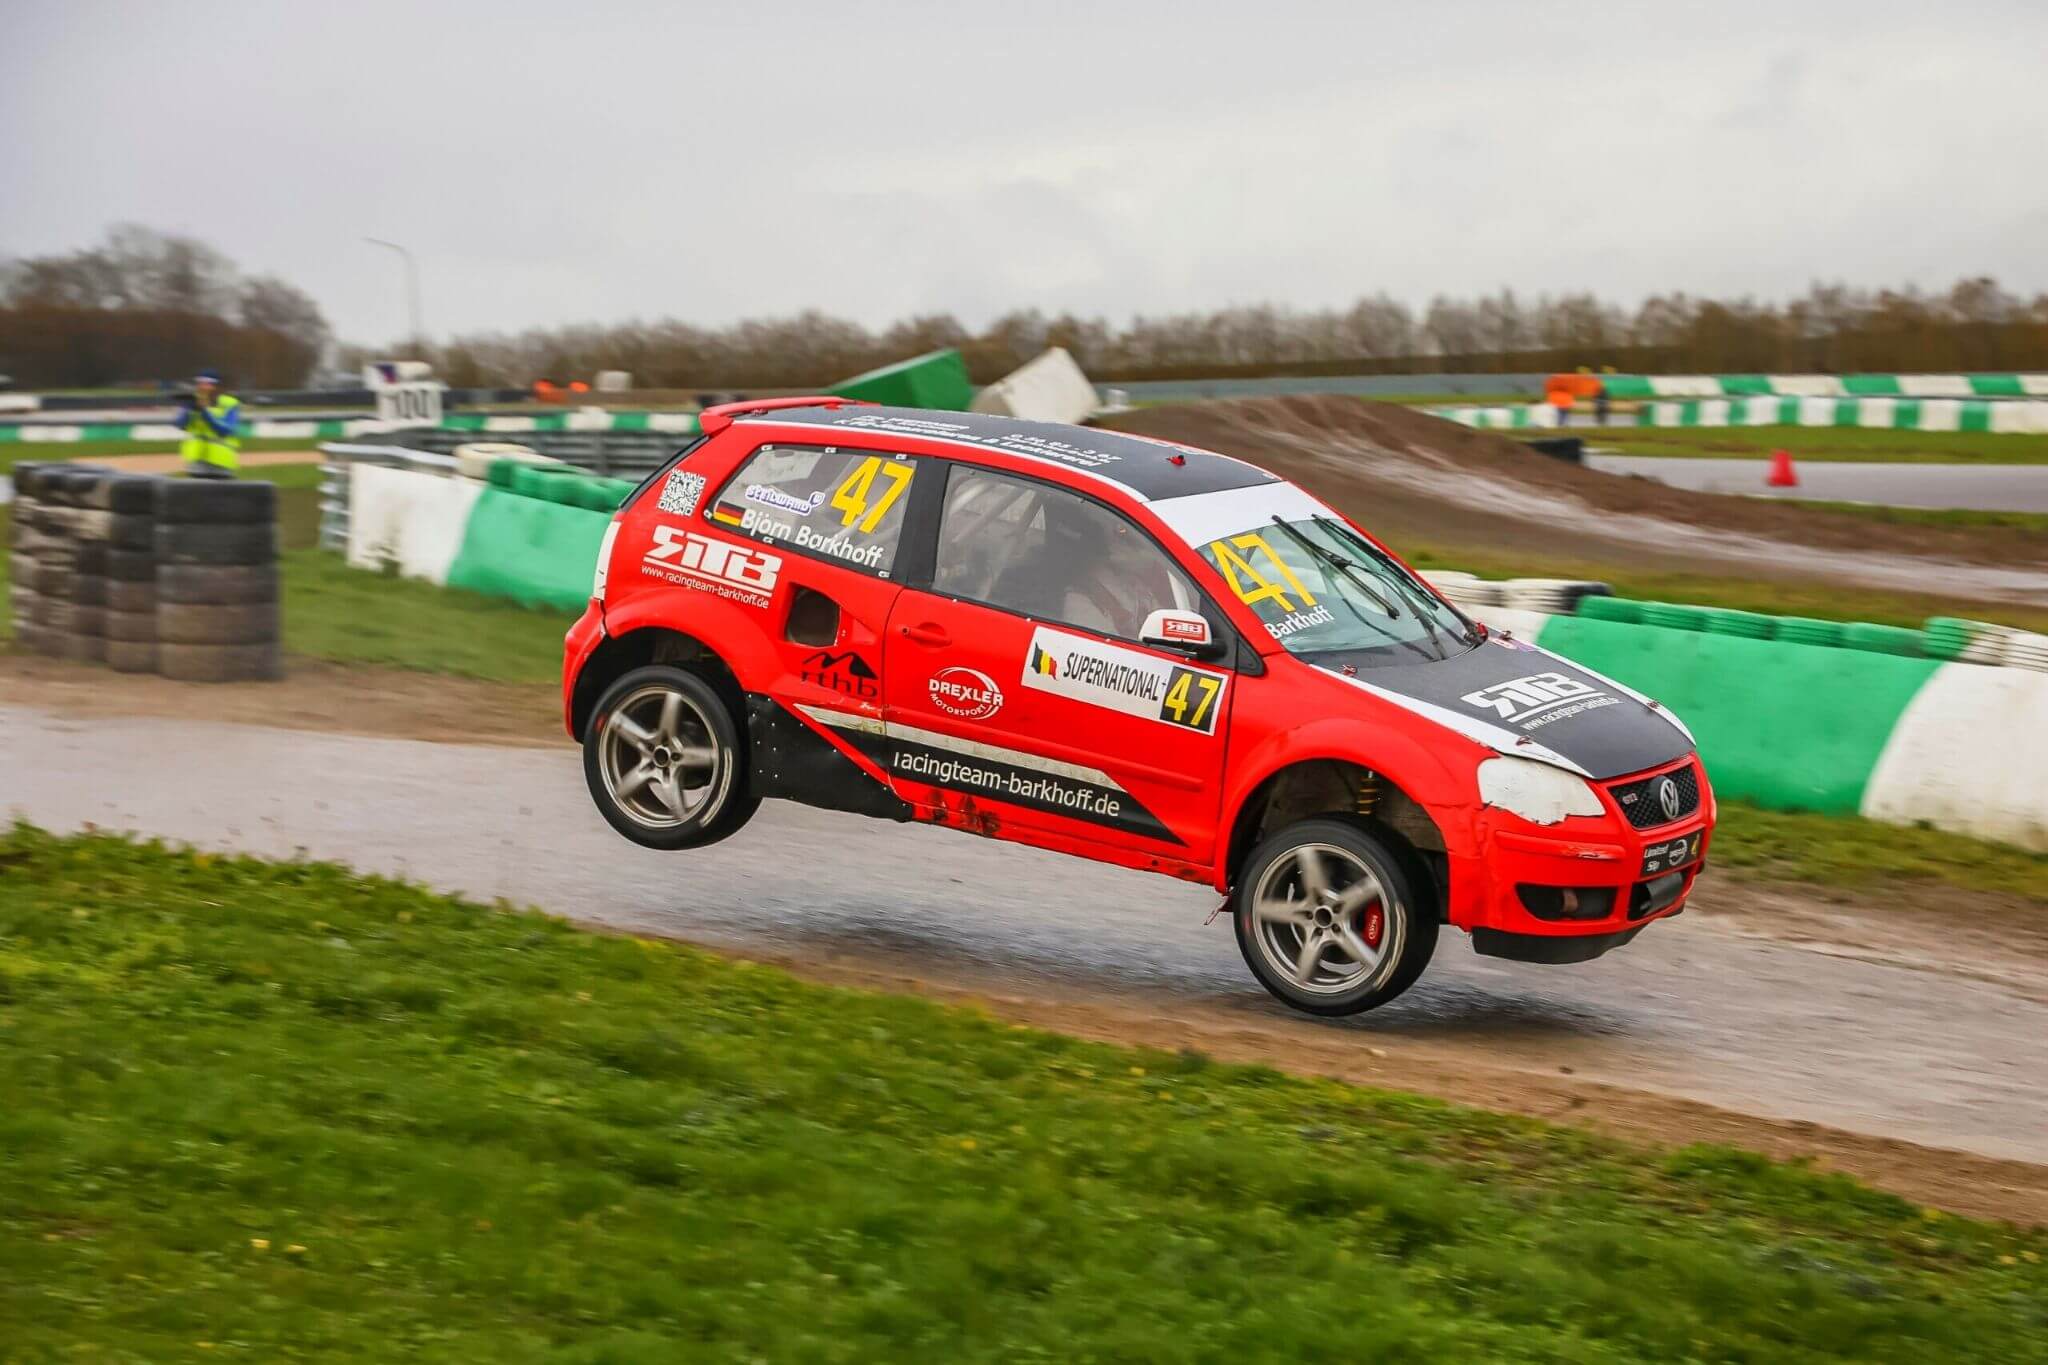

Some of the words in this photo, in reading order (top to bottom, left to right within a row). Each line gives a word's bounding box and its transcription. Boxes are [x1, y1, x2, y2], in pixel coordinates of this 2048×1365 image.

[830, 456, 914, 533] 47
[740, 508, 791, 541] Björn
[795, 525, 884, 568] Barkhoff
[641, 565, 769, 609] www.racingteam-barkhoff.de
[1209, 533, 1317, 612] 47
[1263, 604, 1335, 640] Barkhoff
[928, 678, 1004, 706] DREXLER
[929, 693, 987, 716] MOTORSPORT
[1063, 652, 1160, 701] SUPERNATIONAL
[1164, 672, 1220, 727] 47
[893, 751, 1120, 817] racingteam-barkhoff.de
